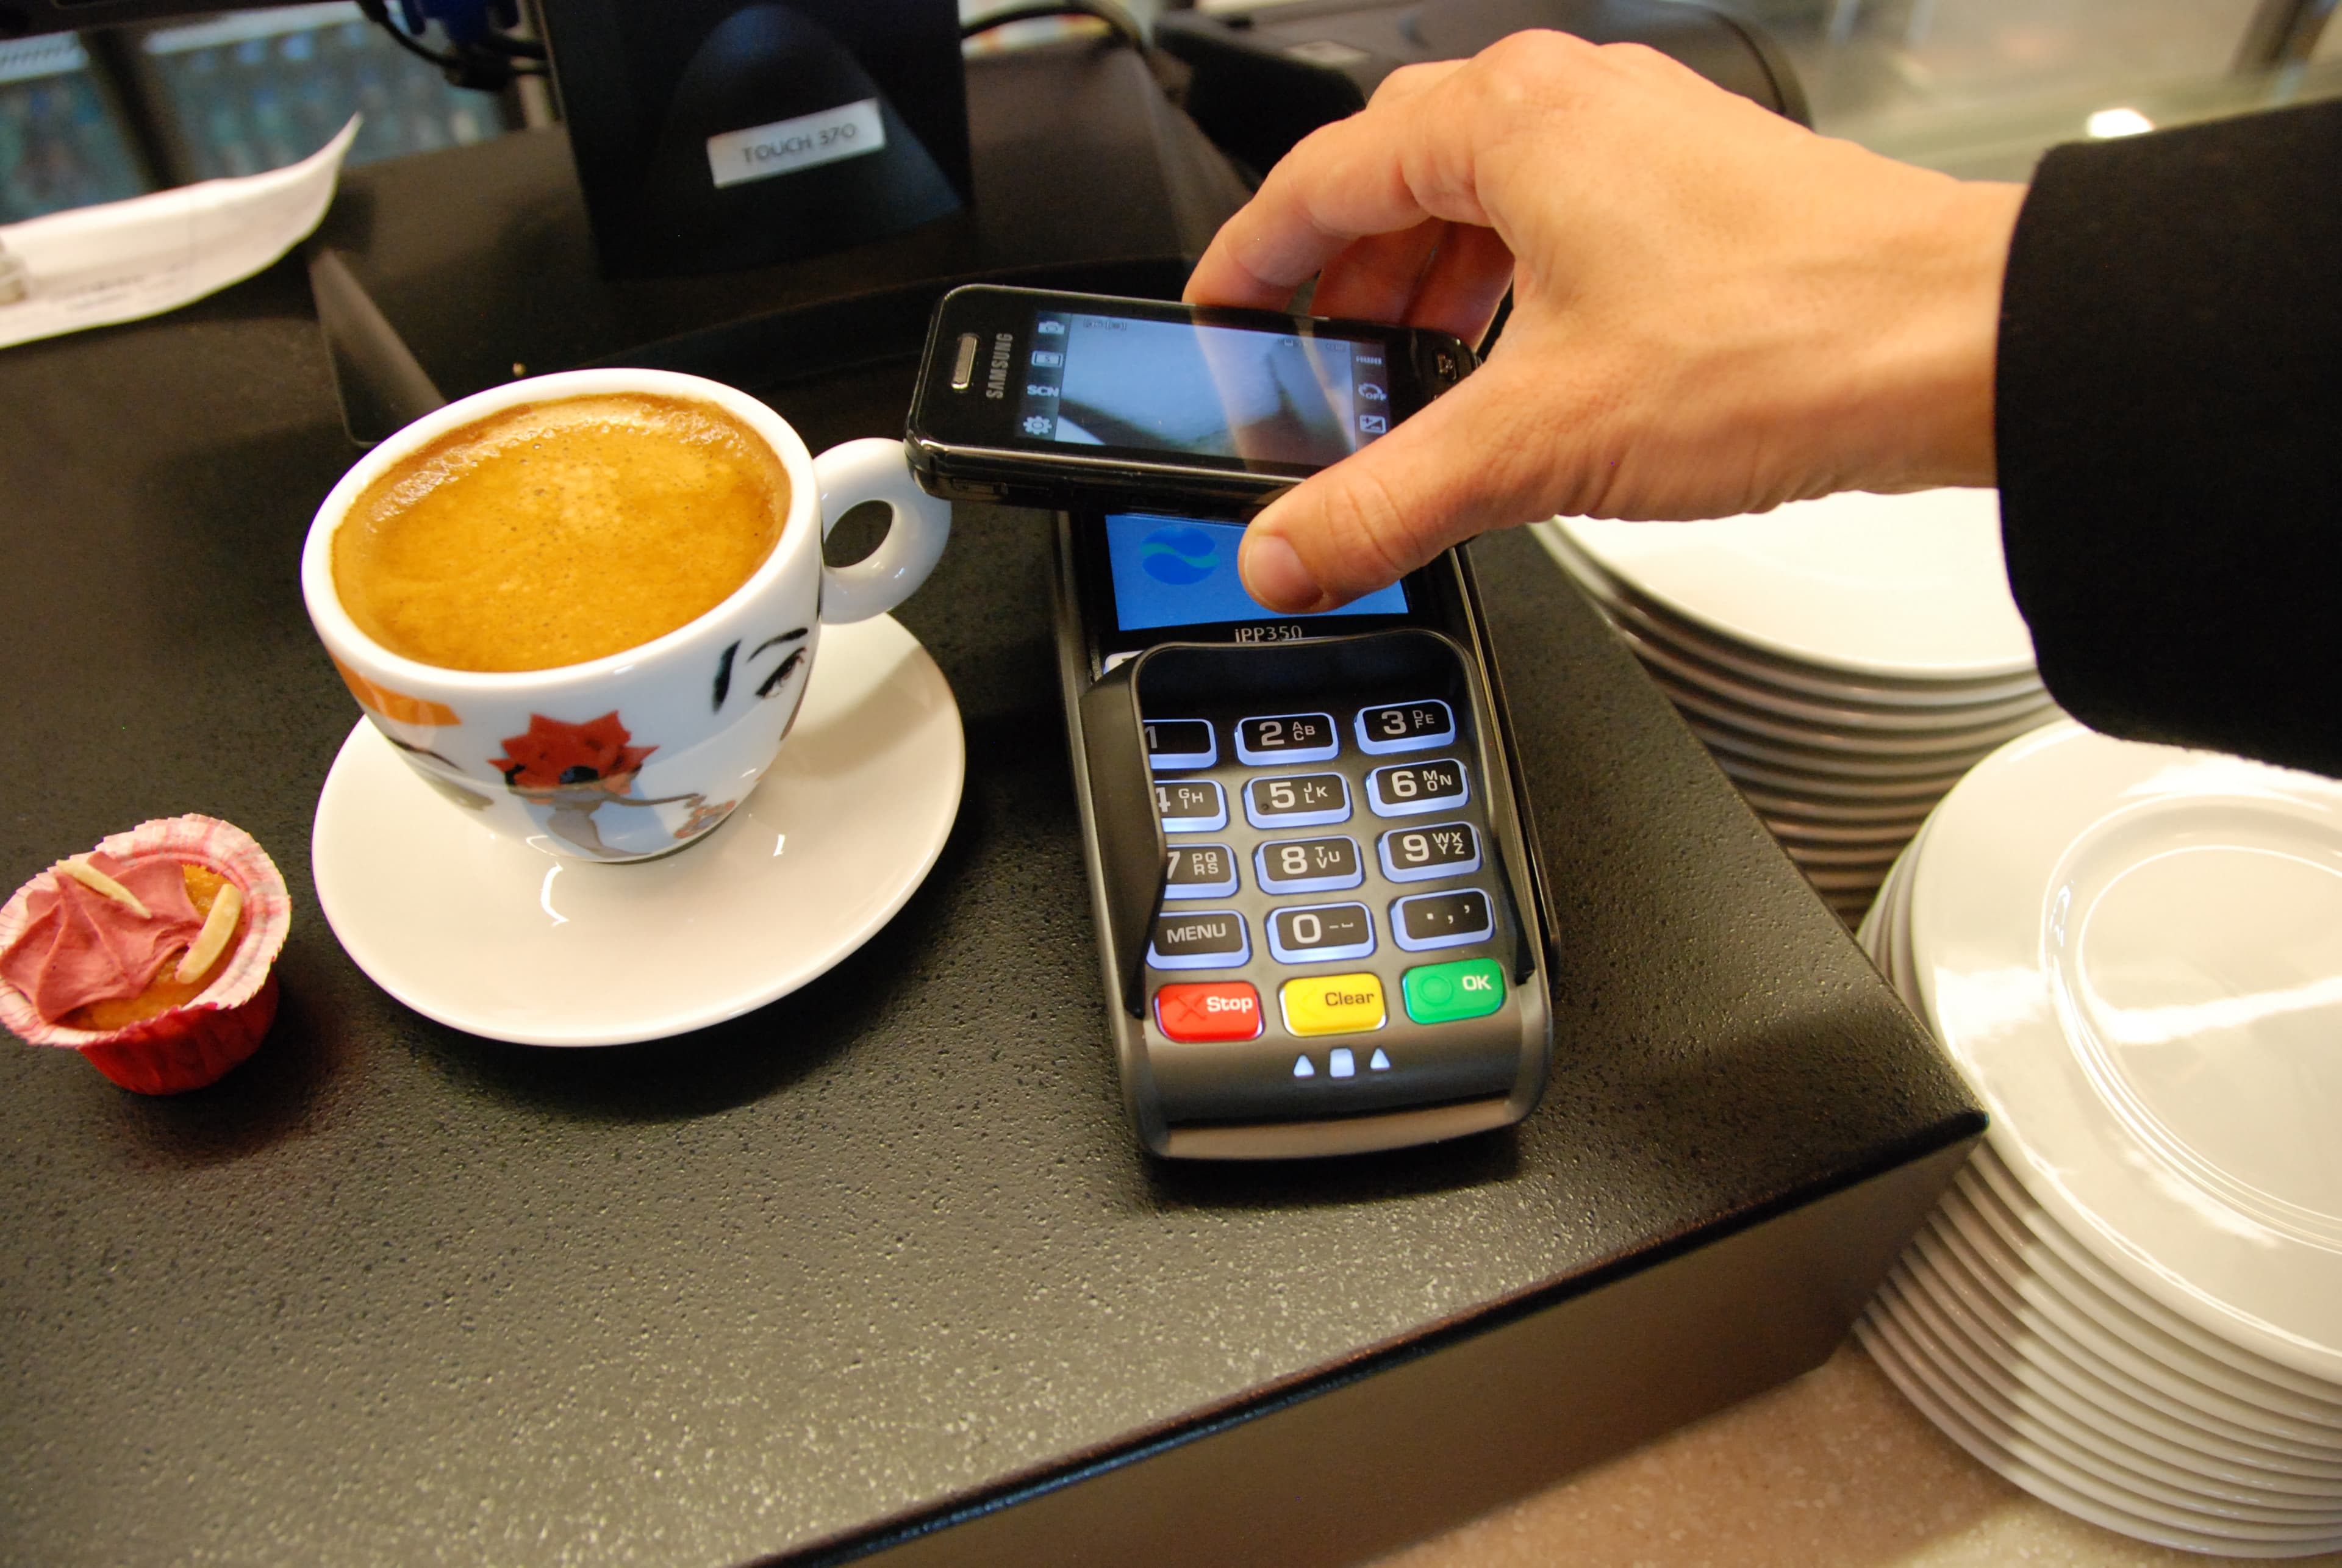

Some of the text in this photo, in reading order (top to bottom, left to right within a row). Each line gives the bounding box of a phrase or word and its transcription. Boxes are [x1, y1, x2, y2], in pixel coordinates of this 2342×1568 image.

[742, 123, 858, 165] TOUCH 370
[986, 333, 1014, 399] SAMSUNG
[1026, 384, 1059, 397] SCN
[1234, 625, 1302, 643] iPP350
[1259, 721, 1285, 746] 2
[1381, 710, 1407, 736] 3
[1145, 725, 1158, 749] 1
[1269, 782, 1296, 809] 5
[1391, 770, 1418, 797] 6
[1281, 846, 1309, 875] 8
[1402, 834, 1430, 862] 9
[1166, 922, 1227, 943] MENU
[1292, 914, 1322, 944] 0
[1462, 975, 1493, 991] OK
[1206, 995, 1253, 1014] Stop
[1325, 991, 1375, 1007] Clear
